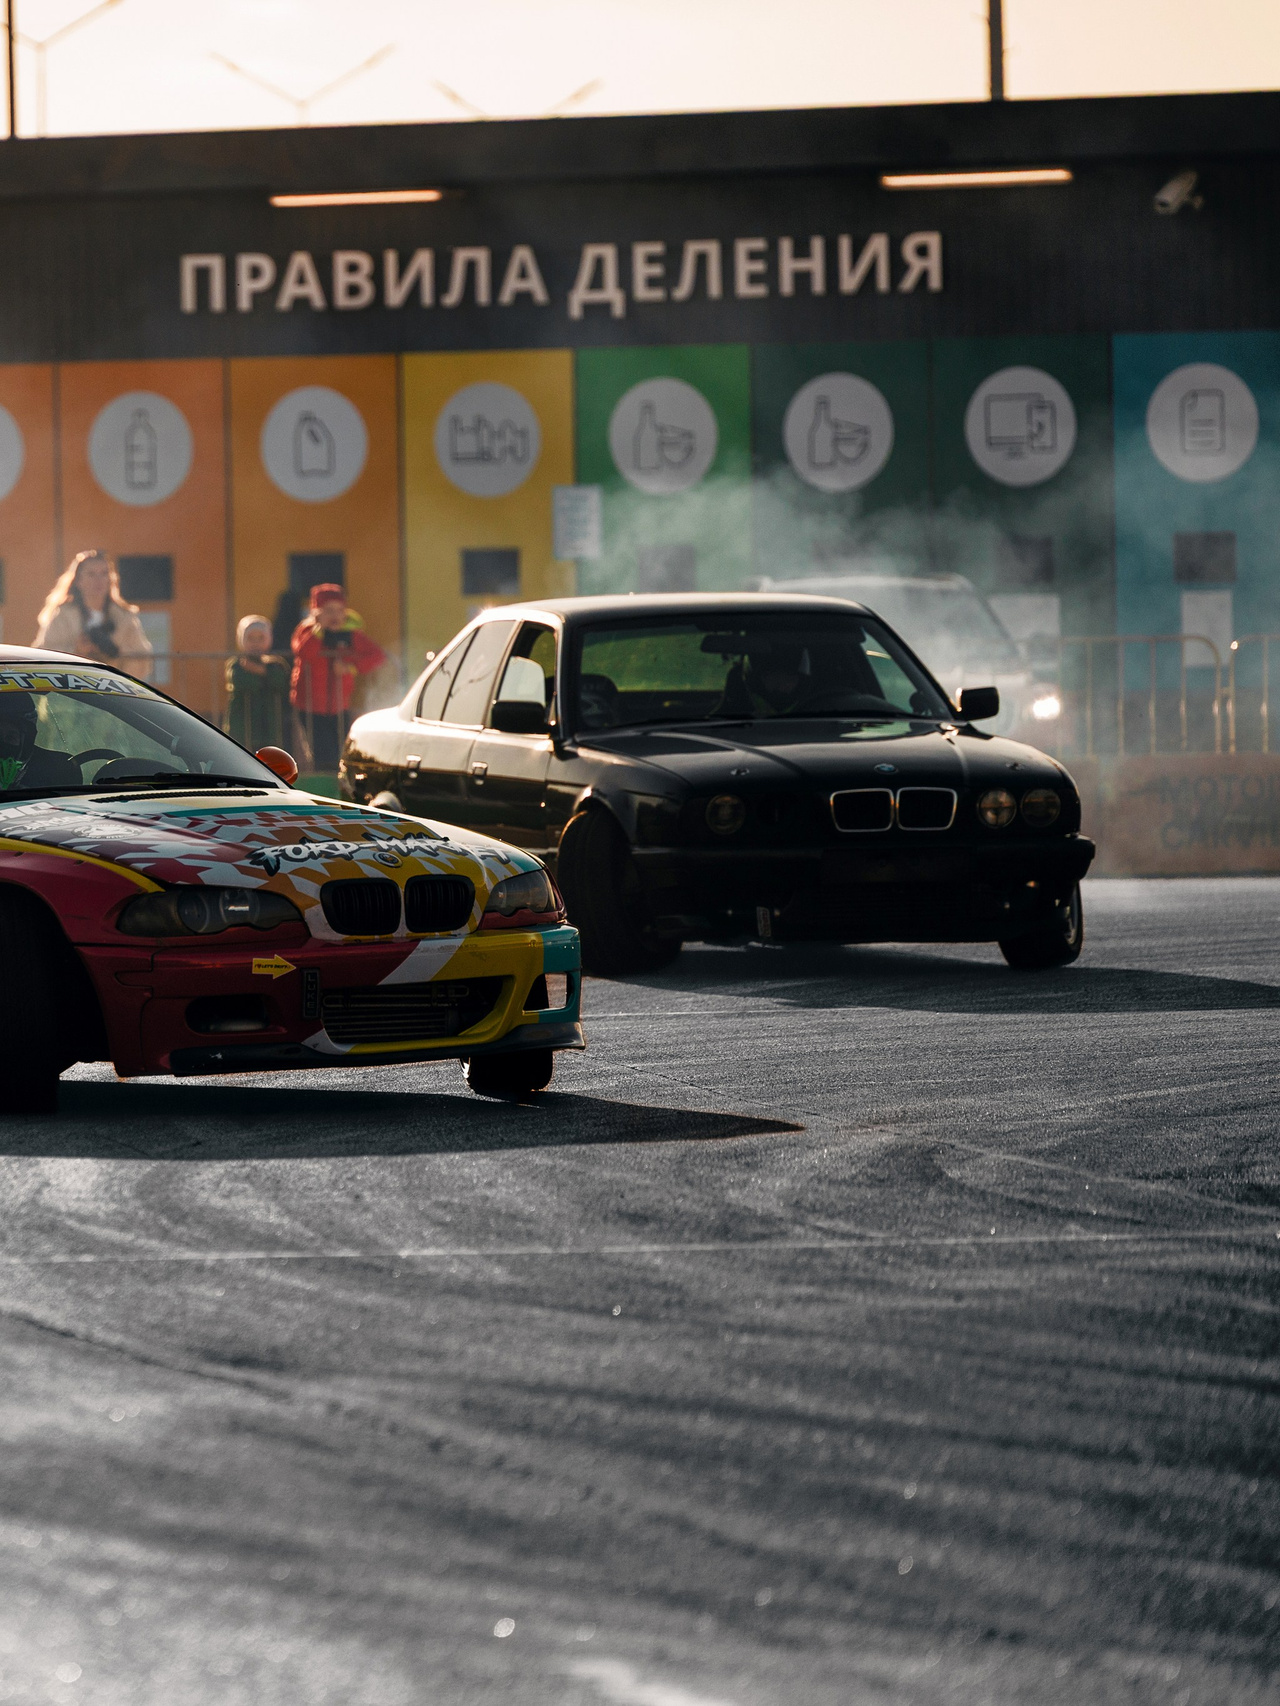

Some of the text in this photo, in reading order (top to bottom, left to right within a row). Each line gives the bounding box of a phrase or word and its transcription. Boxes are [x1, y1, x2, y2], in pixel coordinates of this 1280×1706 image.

[179, 231, 944, 319] ПРАВИЛА ДЕЛЕНИЯ
[33, 673, 133, 695] TAXI
[247, 834, 510, 875] FORD-MARKET
[307, 973, 317, 1009] LUKE
